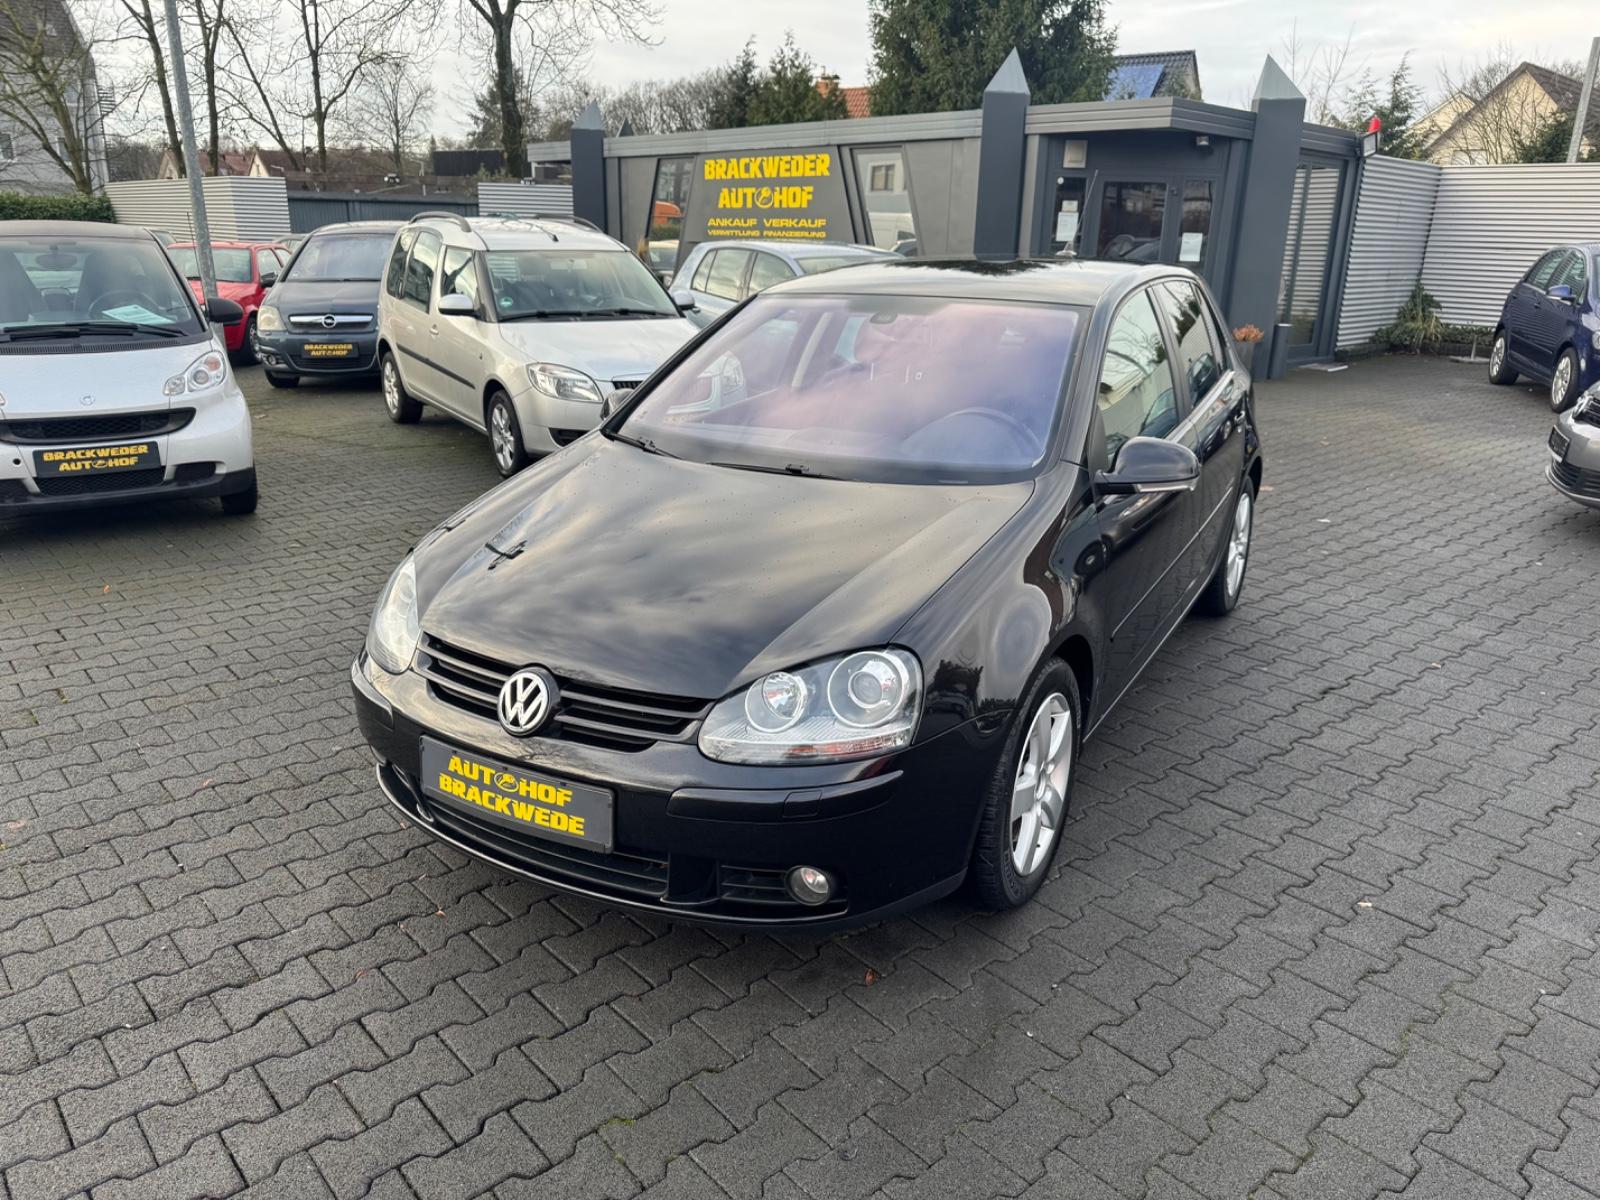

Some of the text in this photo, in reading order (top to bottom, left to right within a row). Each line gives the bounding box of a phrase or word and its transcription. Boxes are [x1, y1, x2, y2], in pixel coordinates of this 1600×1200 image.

[704, 153, 830, 180] BRACKWEDER
[707, 218, 826, 228] ANKAUF VERKAUF
[708, 229, 826, 238] VERMITTLUNG FINANZIERUNG
[303, 343, 353, 351] BRACKWEDER
[42, 444, 149, 462] BRACKWEDER
[438, 772, 585, 837] BRACKWEDE
